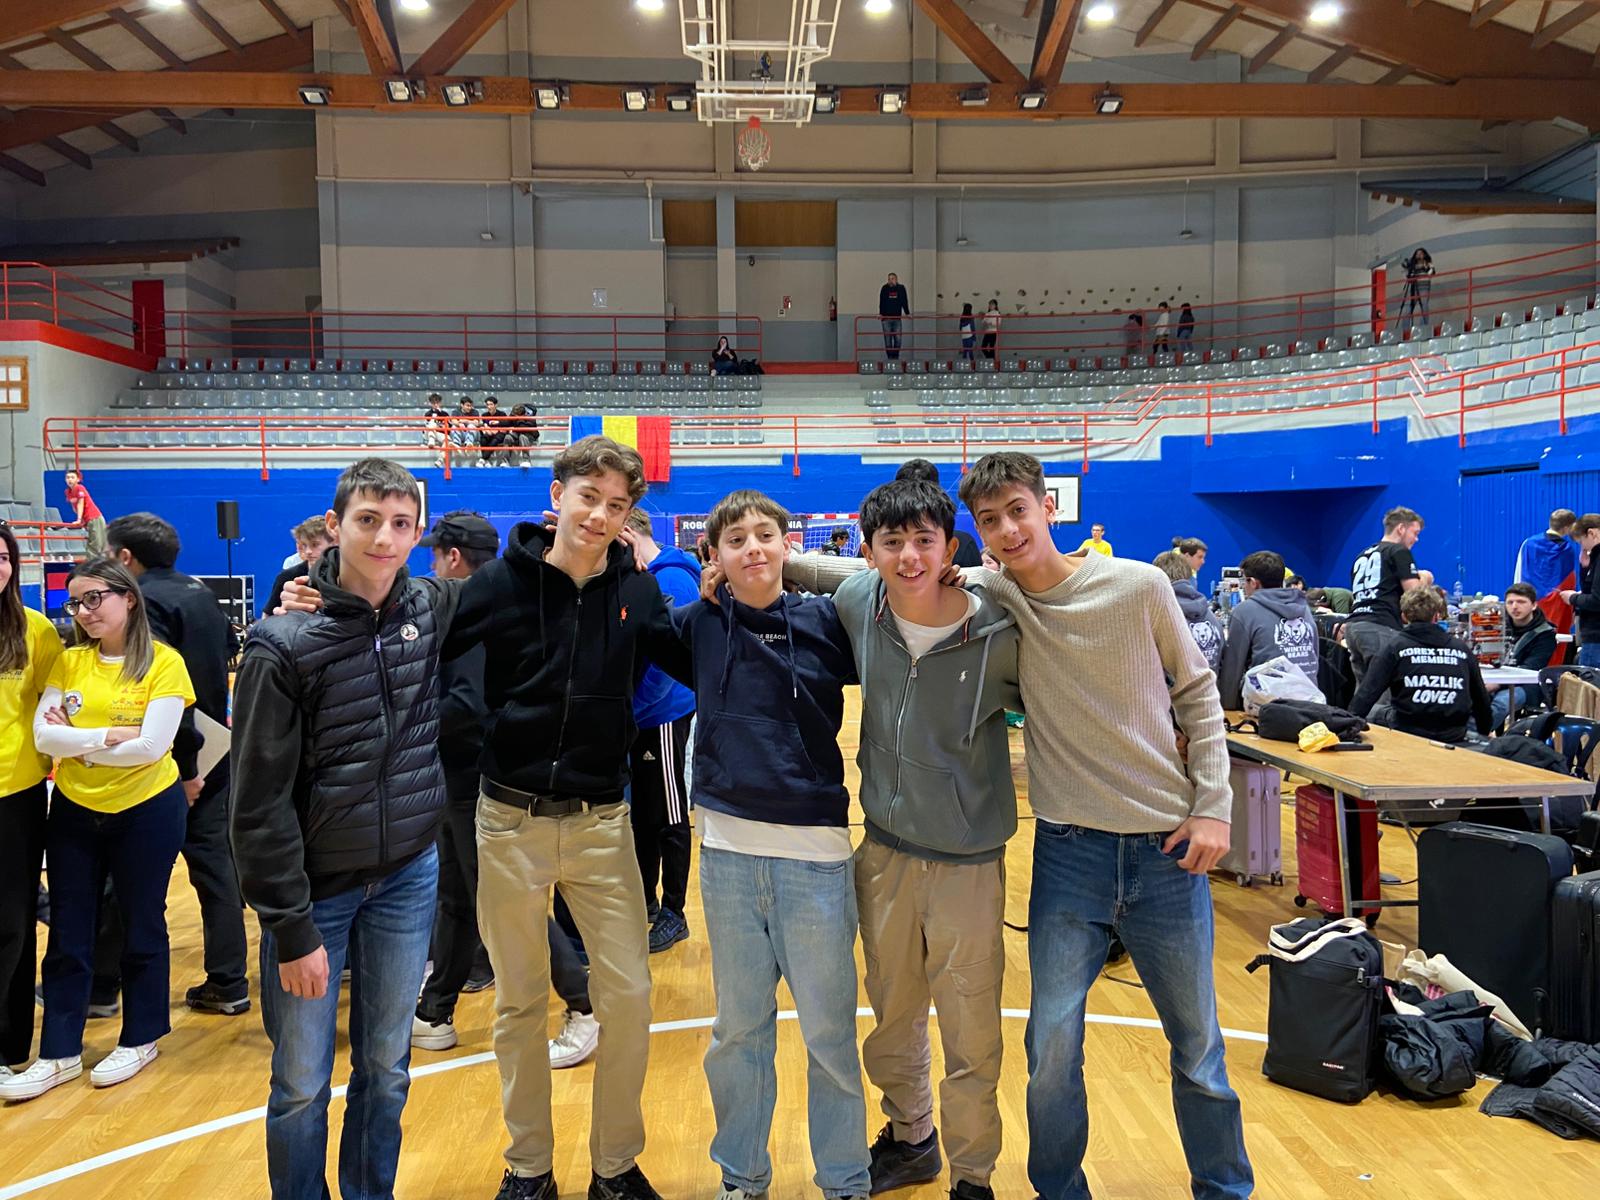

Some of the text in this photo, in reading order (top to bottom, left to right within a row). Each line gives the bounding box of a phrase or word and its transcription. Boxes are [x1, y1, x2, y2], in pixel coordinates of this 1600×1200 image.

[1352, 551, 1381, 594] 29
[1283, 645, 1312, 653] WINTER
[1399, 647, 1468, 660] KOREX TEAM
[1411, 655, 1458, 666] MEMBER
[1404, 675, 1464, 690] MAZLIK
[1412, 689, 1457, 705] LOVER
